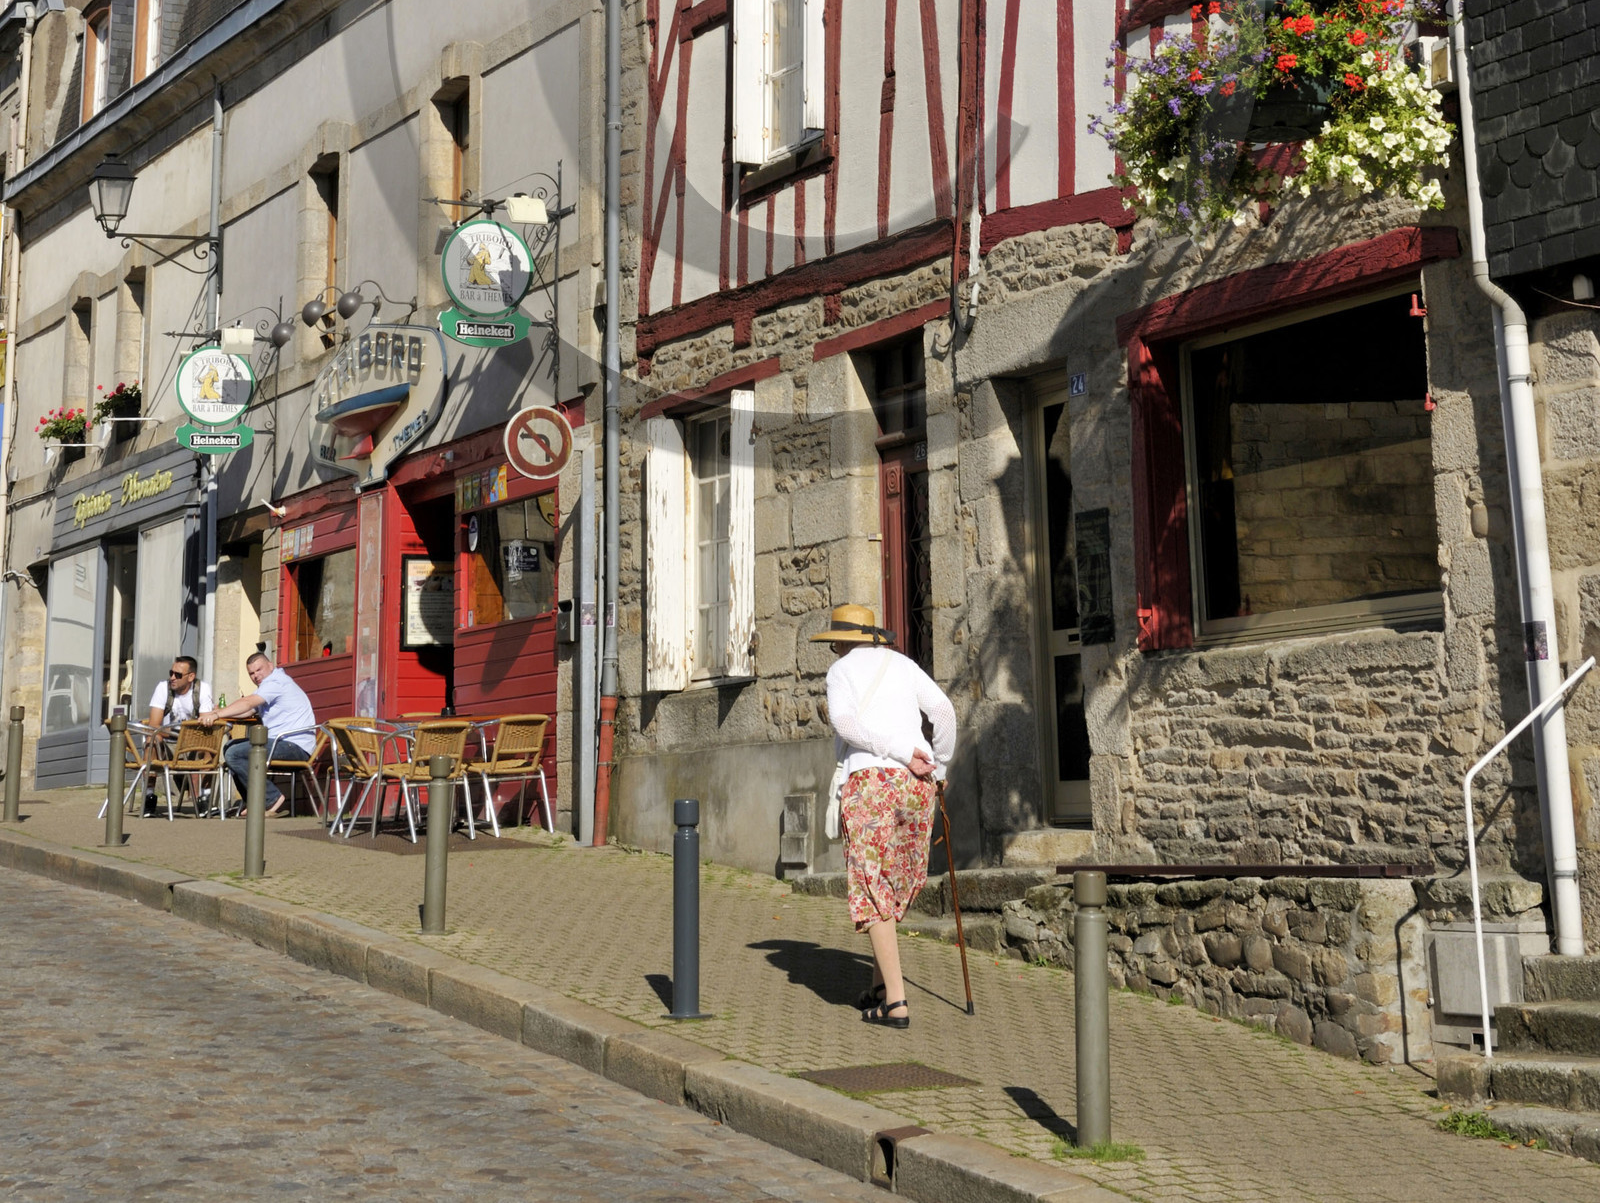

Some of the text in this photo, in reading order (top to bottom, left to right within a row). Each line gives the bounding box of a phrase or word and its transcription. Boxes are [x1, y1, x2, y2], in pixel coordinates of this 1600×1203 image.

[460, 289, 475, 300] BAR
[459, 324, 512, 337] Heineken
[1072, 376, 1084, 394] 24
[192, 404, 205, 413] BAR
[192, 435, 238, 445] Heineken
[320, 444, 337, 462] BAR
[916, 443, 926, 458] 26
